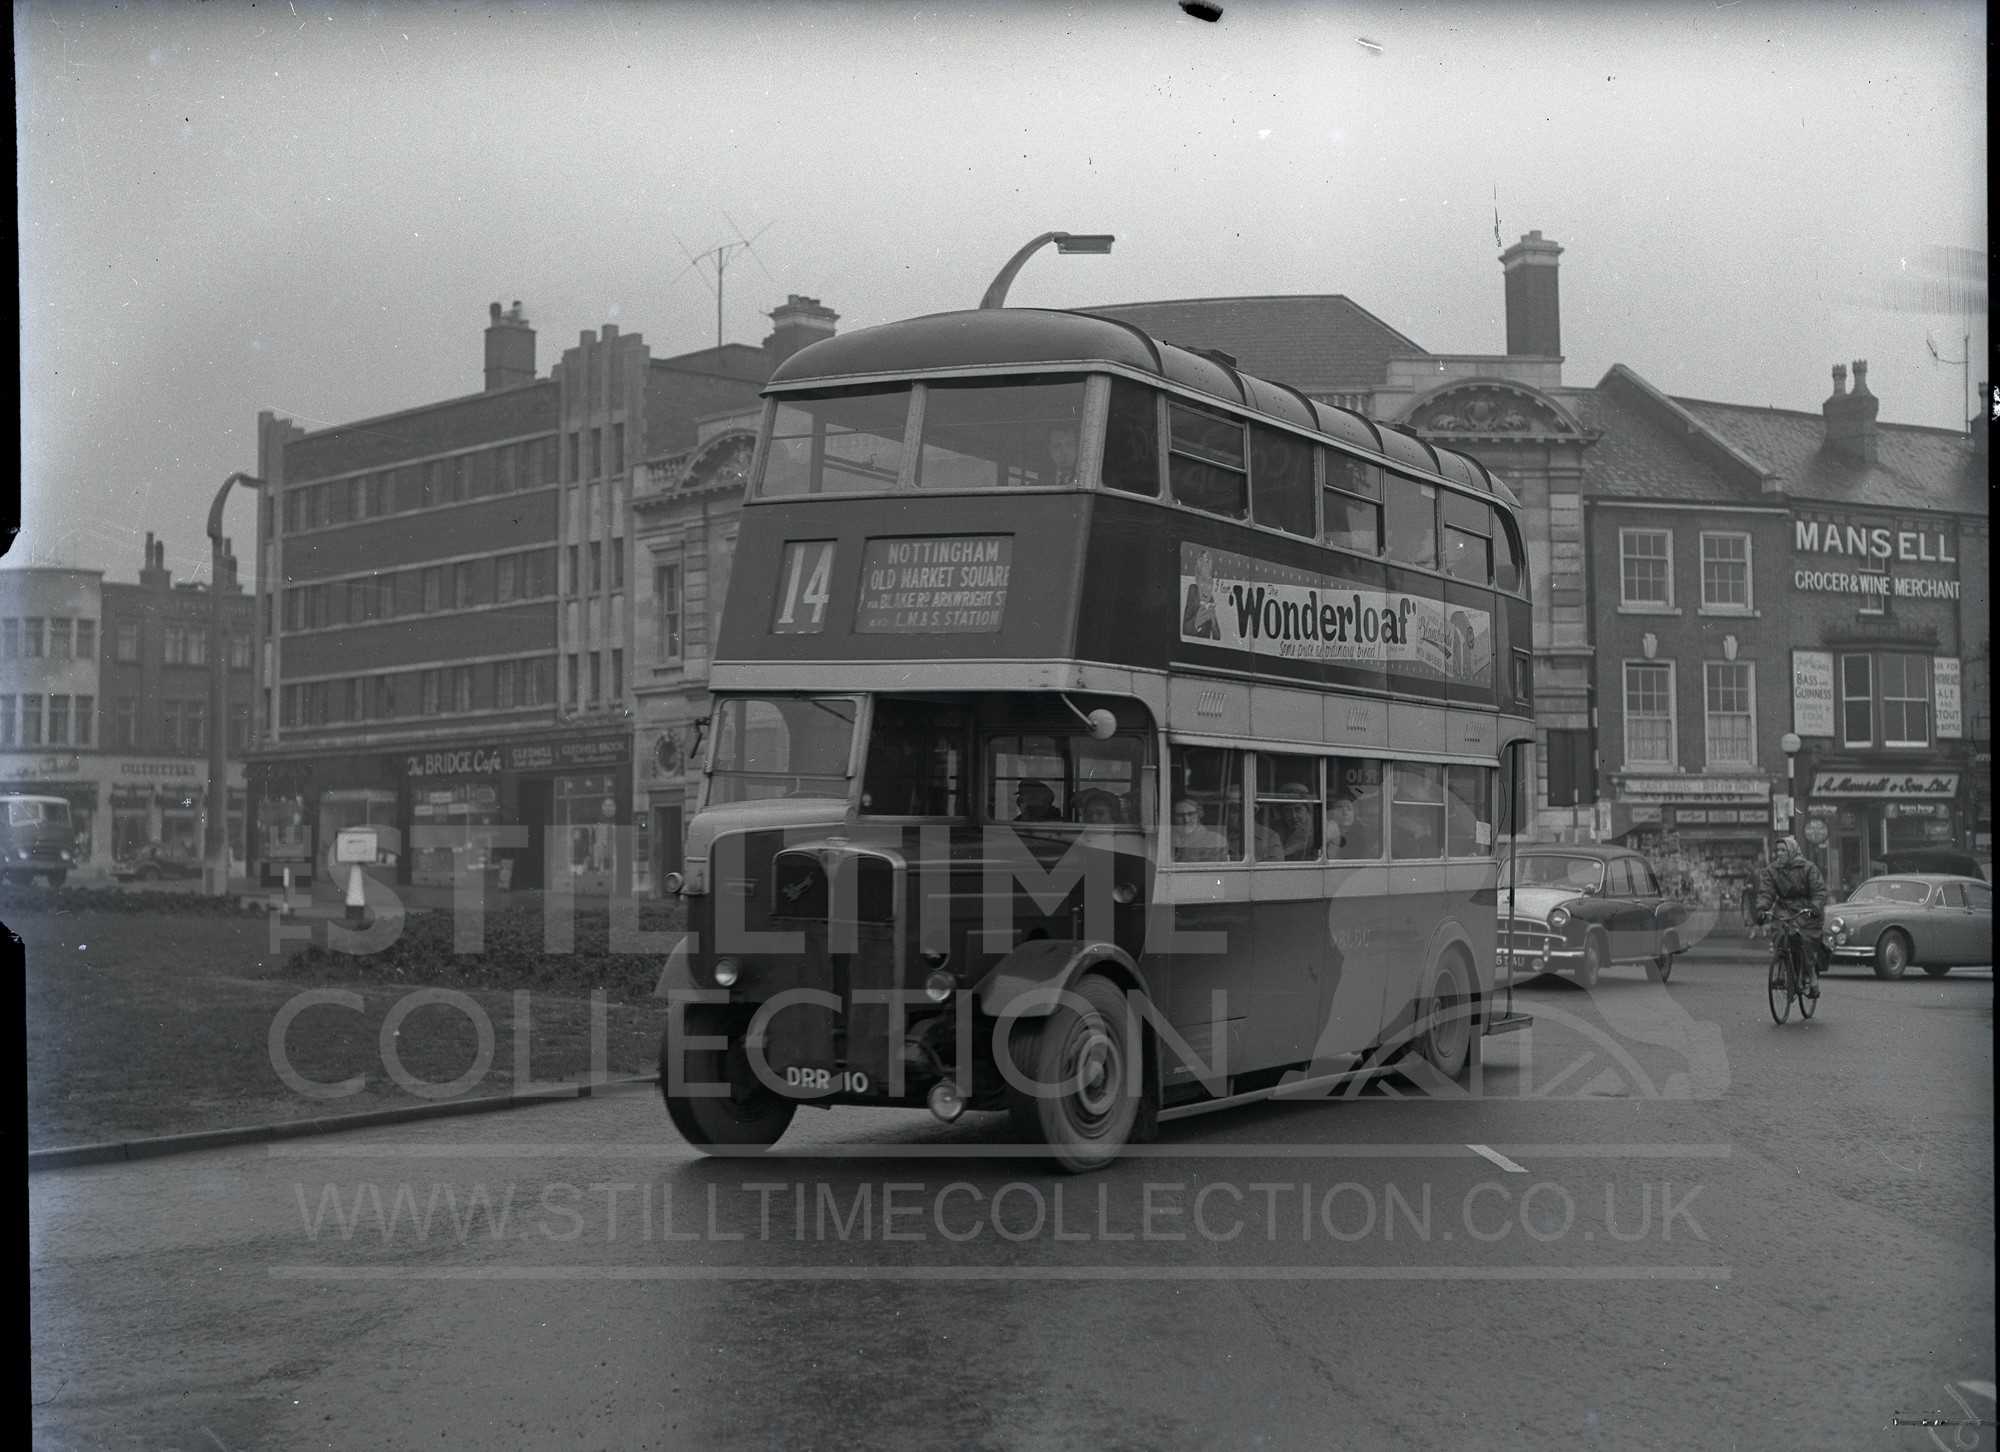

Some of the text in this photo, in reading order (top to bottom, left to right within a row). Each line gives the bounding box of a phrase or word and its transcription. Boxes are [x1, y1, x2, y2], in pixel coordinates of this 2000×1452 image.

[887, 541, 1000, 565] NOTTINGHAM
[1795, 520, 1957, 563] MANSELL
[777, 542, 834, 623] 14
[870, 565, 1010, 591] OLD MARKET SQUARE
[1894, 577, 1961, 600] MERCHANT
[943, 610, 998, 626] STATION
[1795, 687, 1832, 701] GUINNESS
[425, 751, 473, 776] BRIDGE
[786, 1066, 869, 1093] DRR 10
